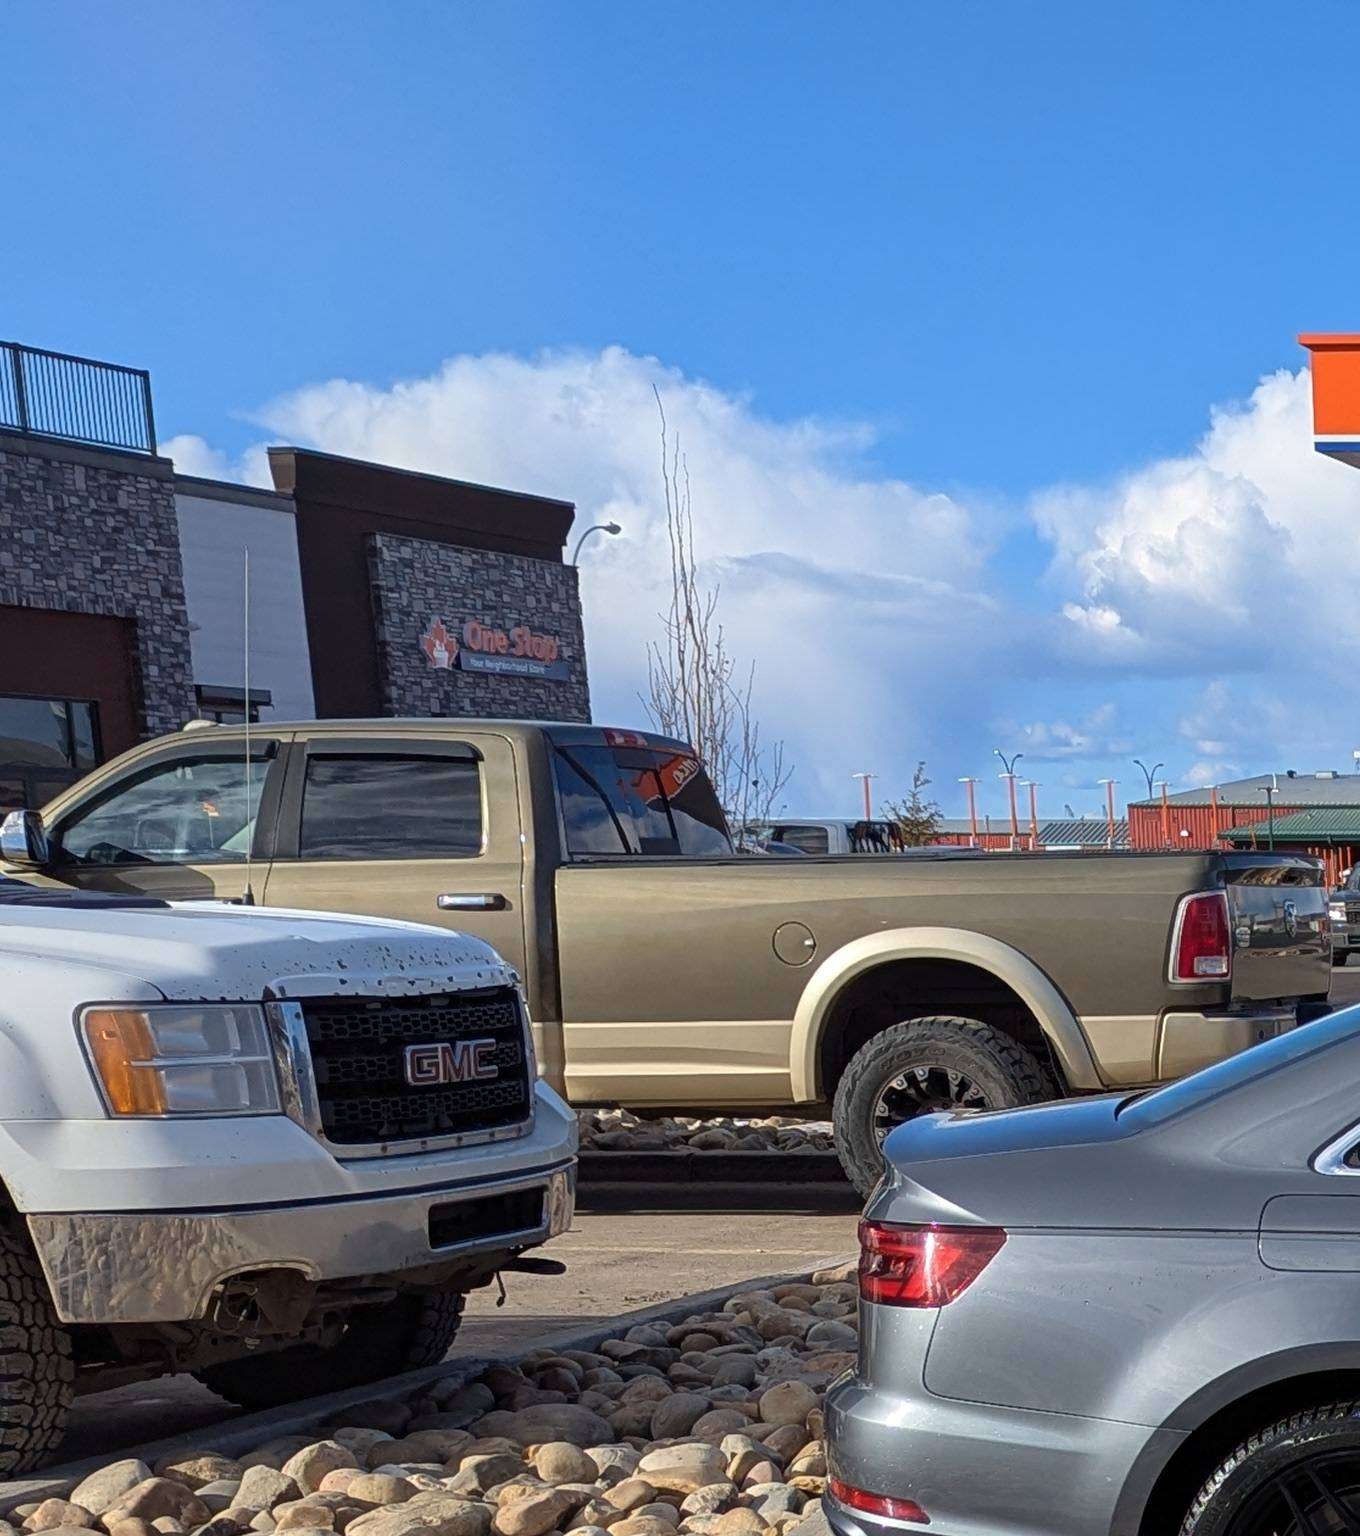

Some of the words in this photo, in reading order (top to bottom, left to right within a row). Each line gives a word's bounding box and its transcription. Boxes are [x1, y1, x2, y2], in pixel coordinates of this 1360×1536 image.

[463, 619, 509, 654] One
[509, 625, 560, 666] Stop
[404, 1039, 499, 1086] GMC
